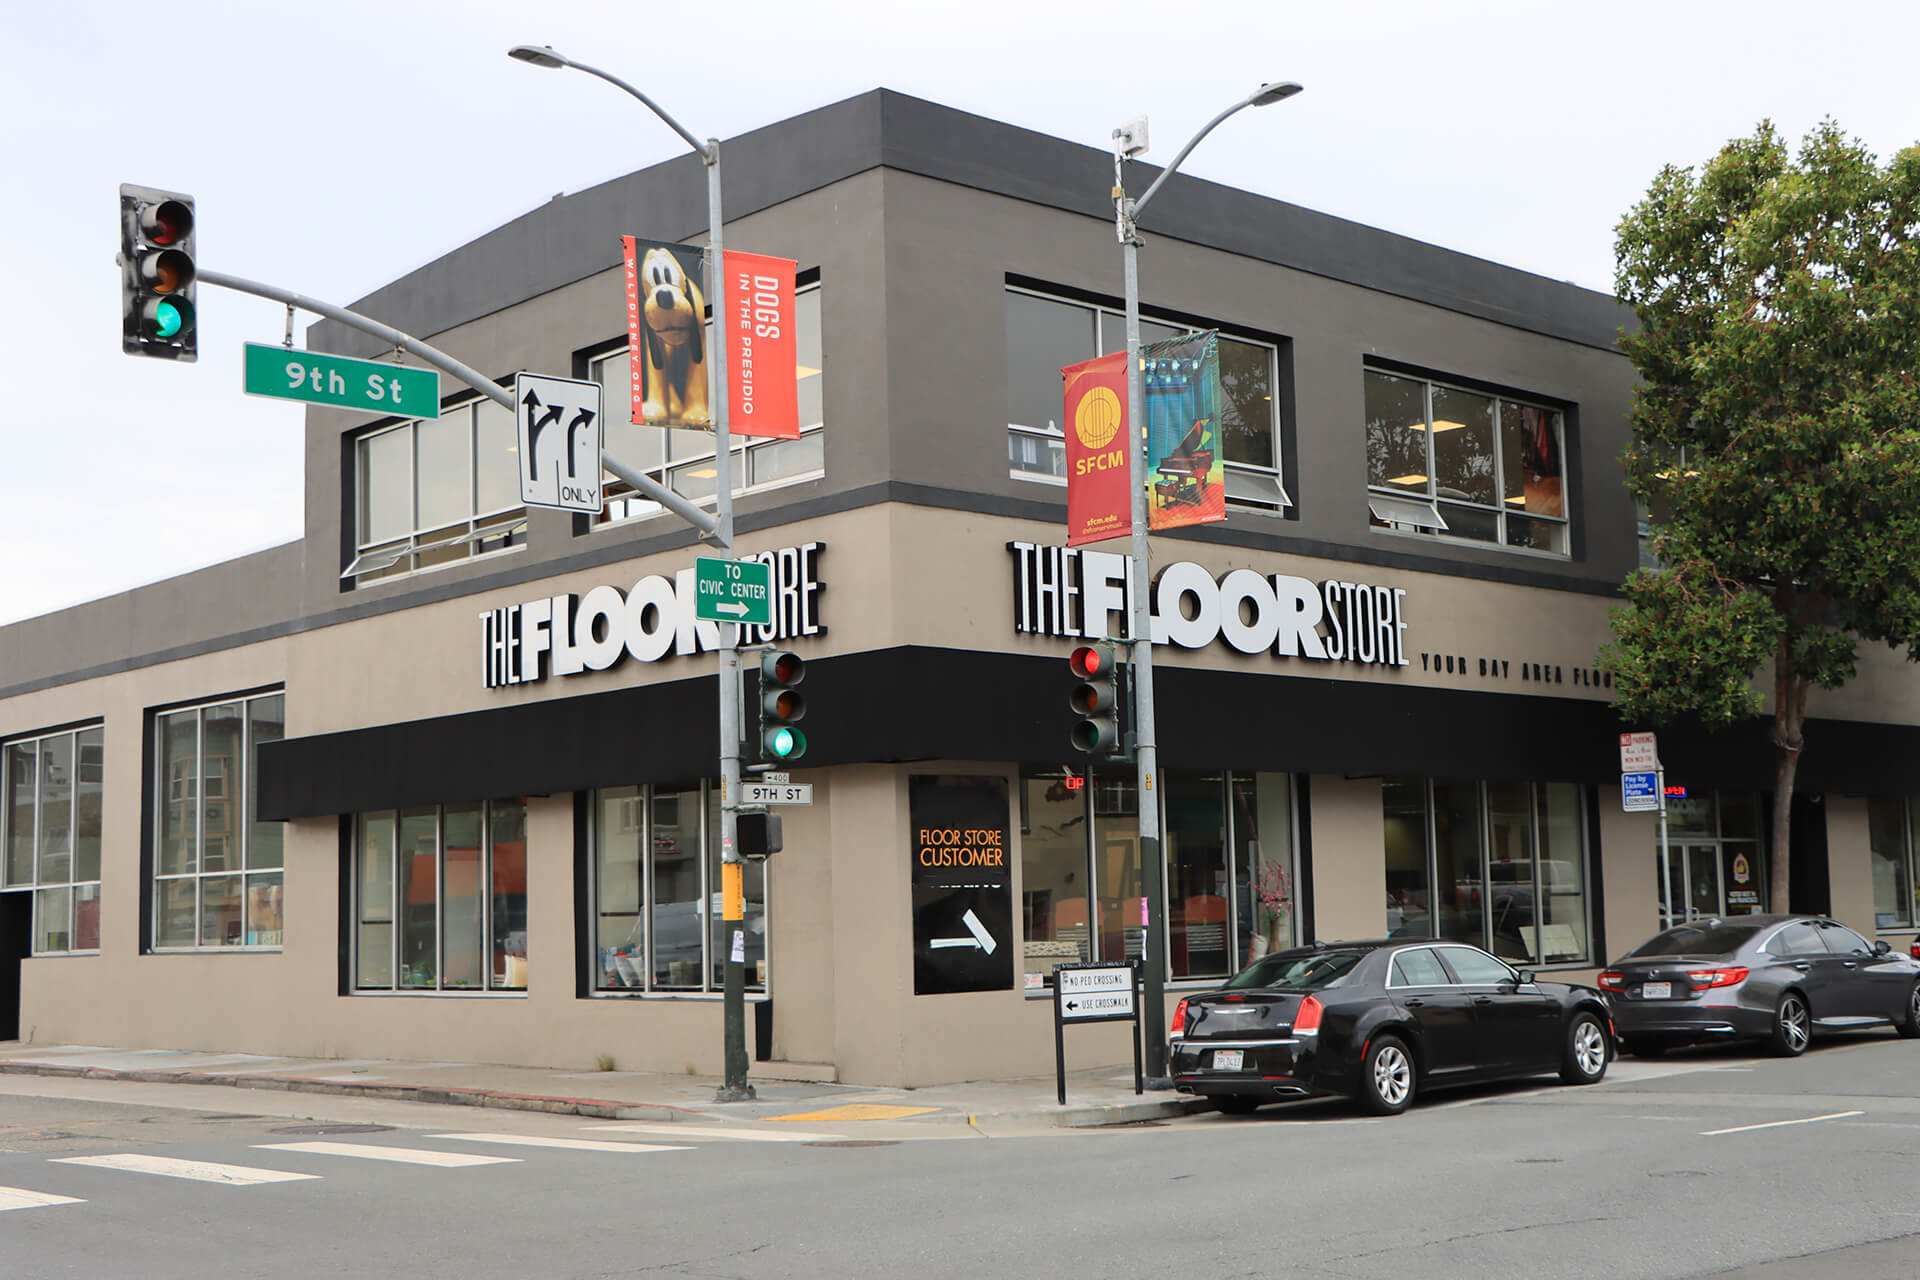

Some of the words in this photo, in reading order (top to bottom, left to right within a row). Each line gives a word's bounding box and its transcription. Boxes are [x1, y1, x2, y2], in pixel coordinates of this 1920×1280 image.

[739, 273, 750, 290] IN
[740, 297, 751, 330] THE
[754, 275, 780, 339] DOGS
[626, 258, 641, 403] WALTDISNEY.ORG
[285, 362, 345, 395] 9th
[366, 374, 402, 404] St
[741, 337, 753, 414] PRESIDIO
[1076, 450, 1124, 476] SFCM
[562, 486, 596, 504] ONLY
[724, 564, 741, 580] TO
[700, 579, 724, 596] CIVIC
[731, 582, 766, 600] CENTER
[1007, 541, 1081, 638] THE
[1323, 579, 1410, 666] STORE
[479, 603, 522, 689] THE
[722, 542, 826, 646] ORE
[1421, 653, 1467, 675] YOUR
[1479, 658, 1509, 679] BAY
[1522, 662, 1562, 684] AREA
[773, 774, 788, 783] 400
[753, 788, 778, 800] 9TH
[787, 788, 802, 800] ST
[920, 829, 960, 845] FLOOR
[964, 829, 1002, 846] STORE
[920, 847, 1003, 867] CUSTOMER
[1070, 976, 1079, 986] NO
[1080, 975, 1092, 986] PED
[1094, 975, 1123, 985] CROSSING
[1082, 999, 1093, 1010] USE
[1095, 998, 1129, 1009] CROSSWALK
